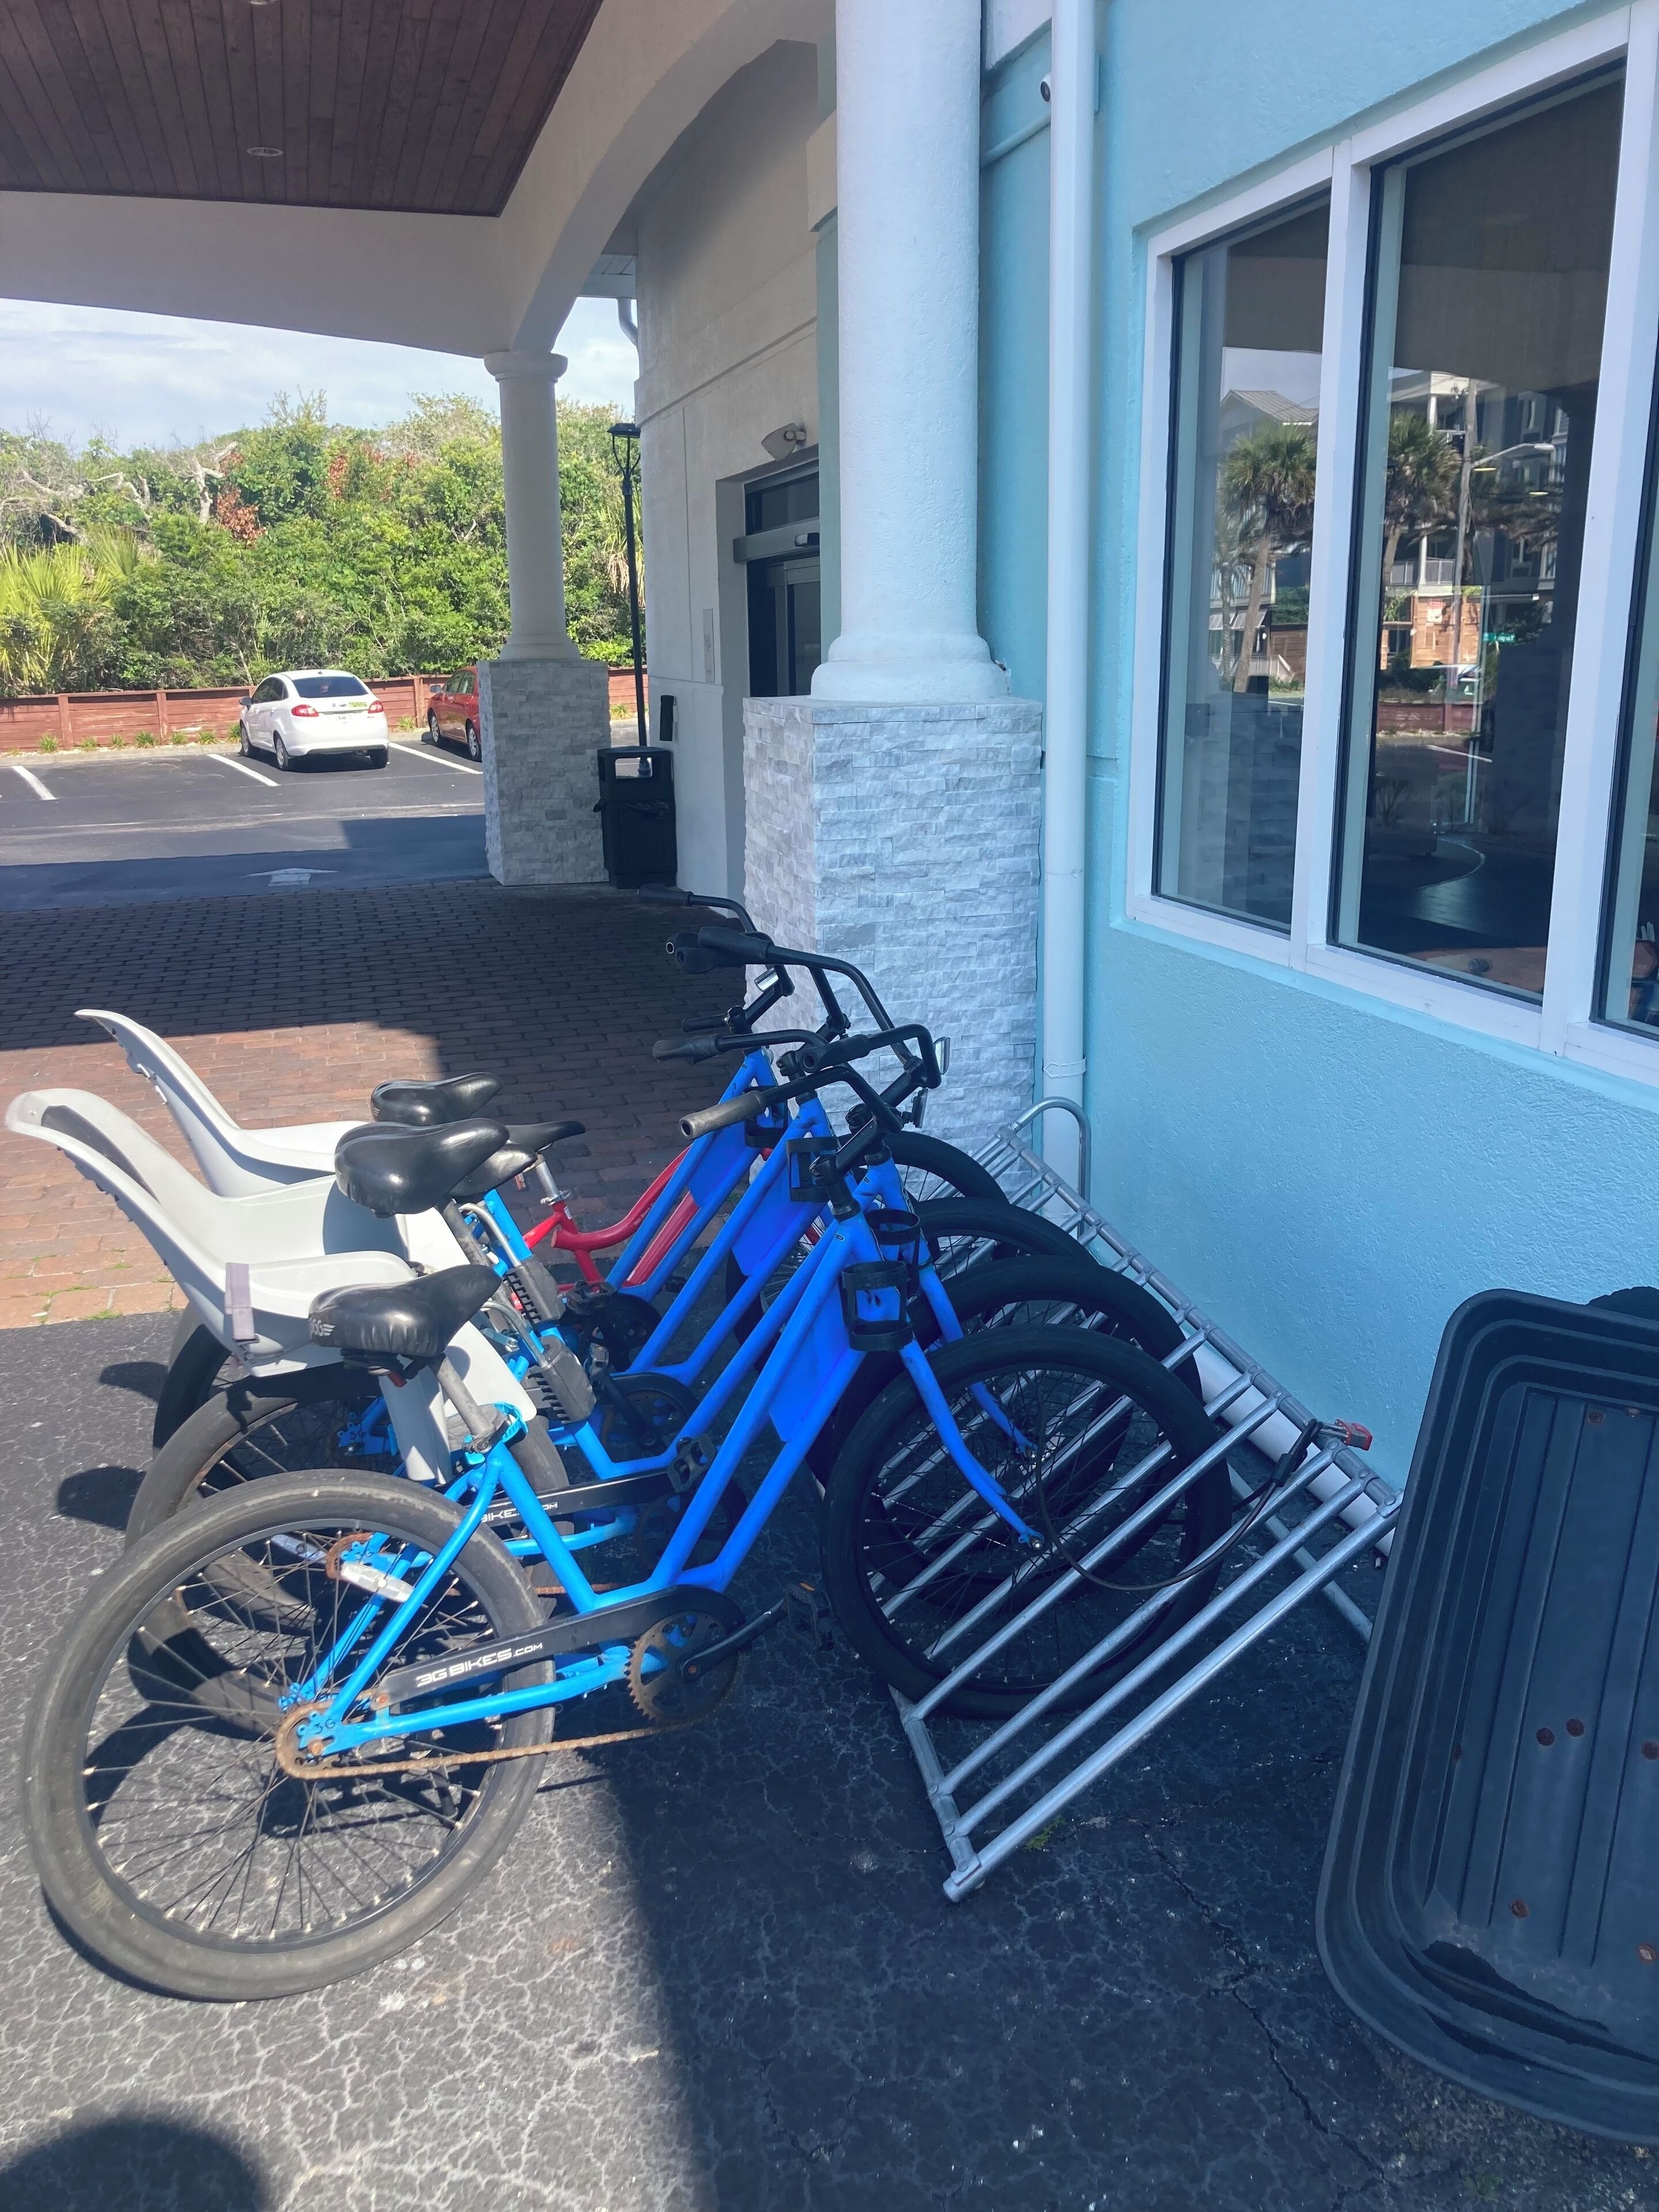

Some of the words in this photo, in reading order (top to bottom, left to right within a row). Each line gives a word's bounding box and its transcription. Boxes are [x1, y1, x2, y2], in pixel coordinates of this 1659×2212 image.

[416, 1668, 448, 1687] 3G
[449, 1642, 543, 1677] BIKES.COM
[314, 1718, 336, 1734] 3G
